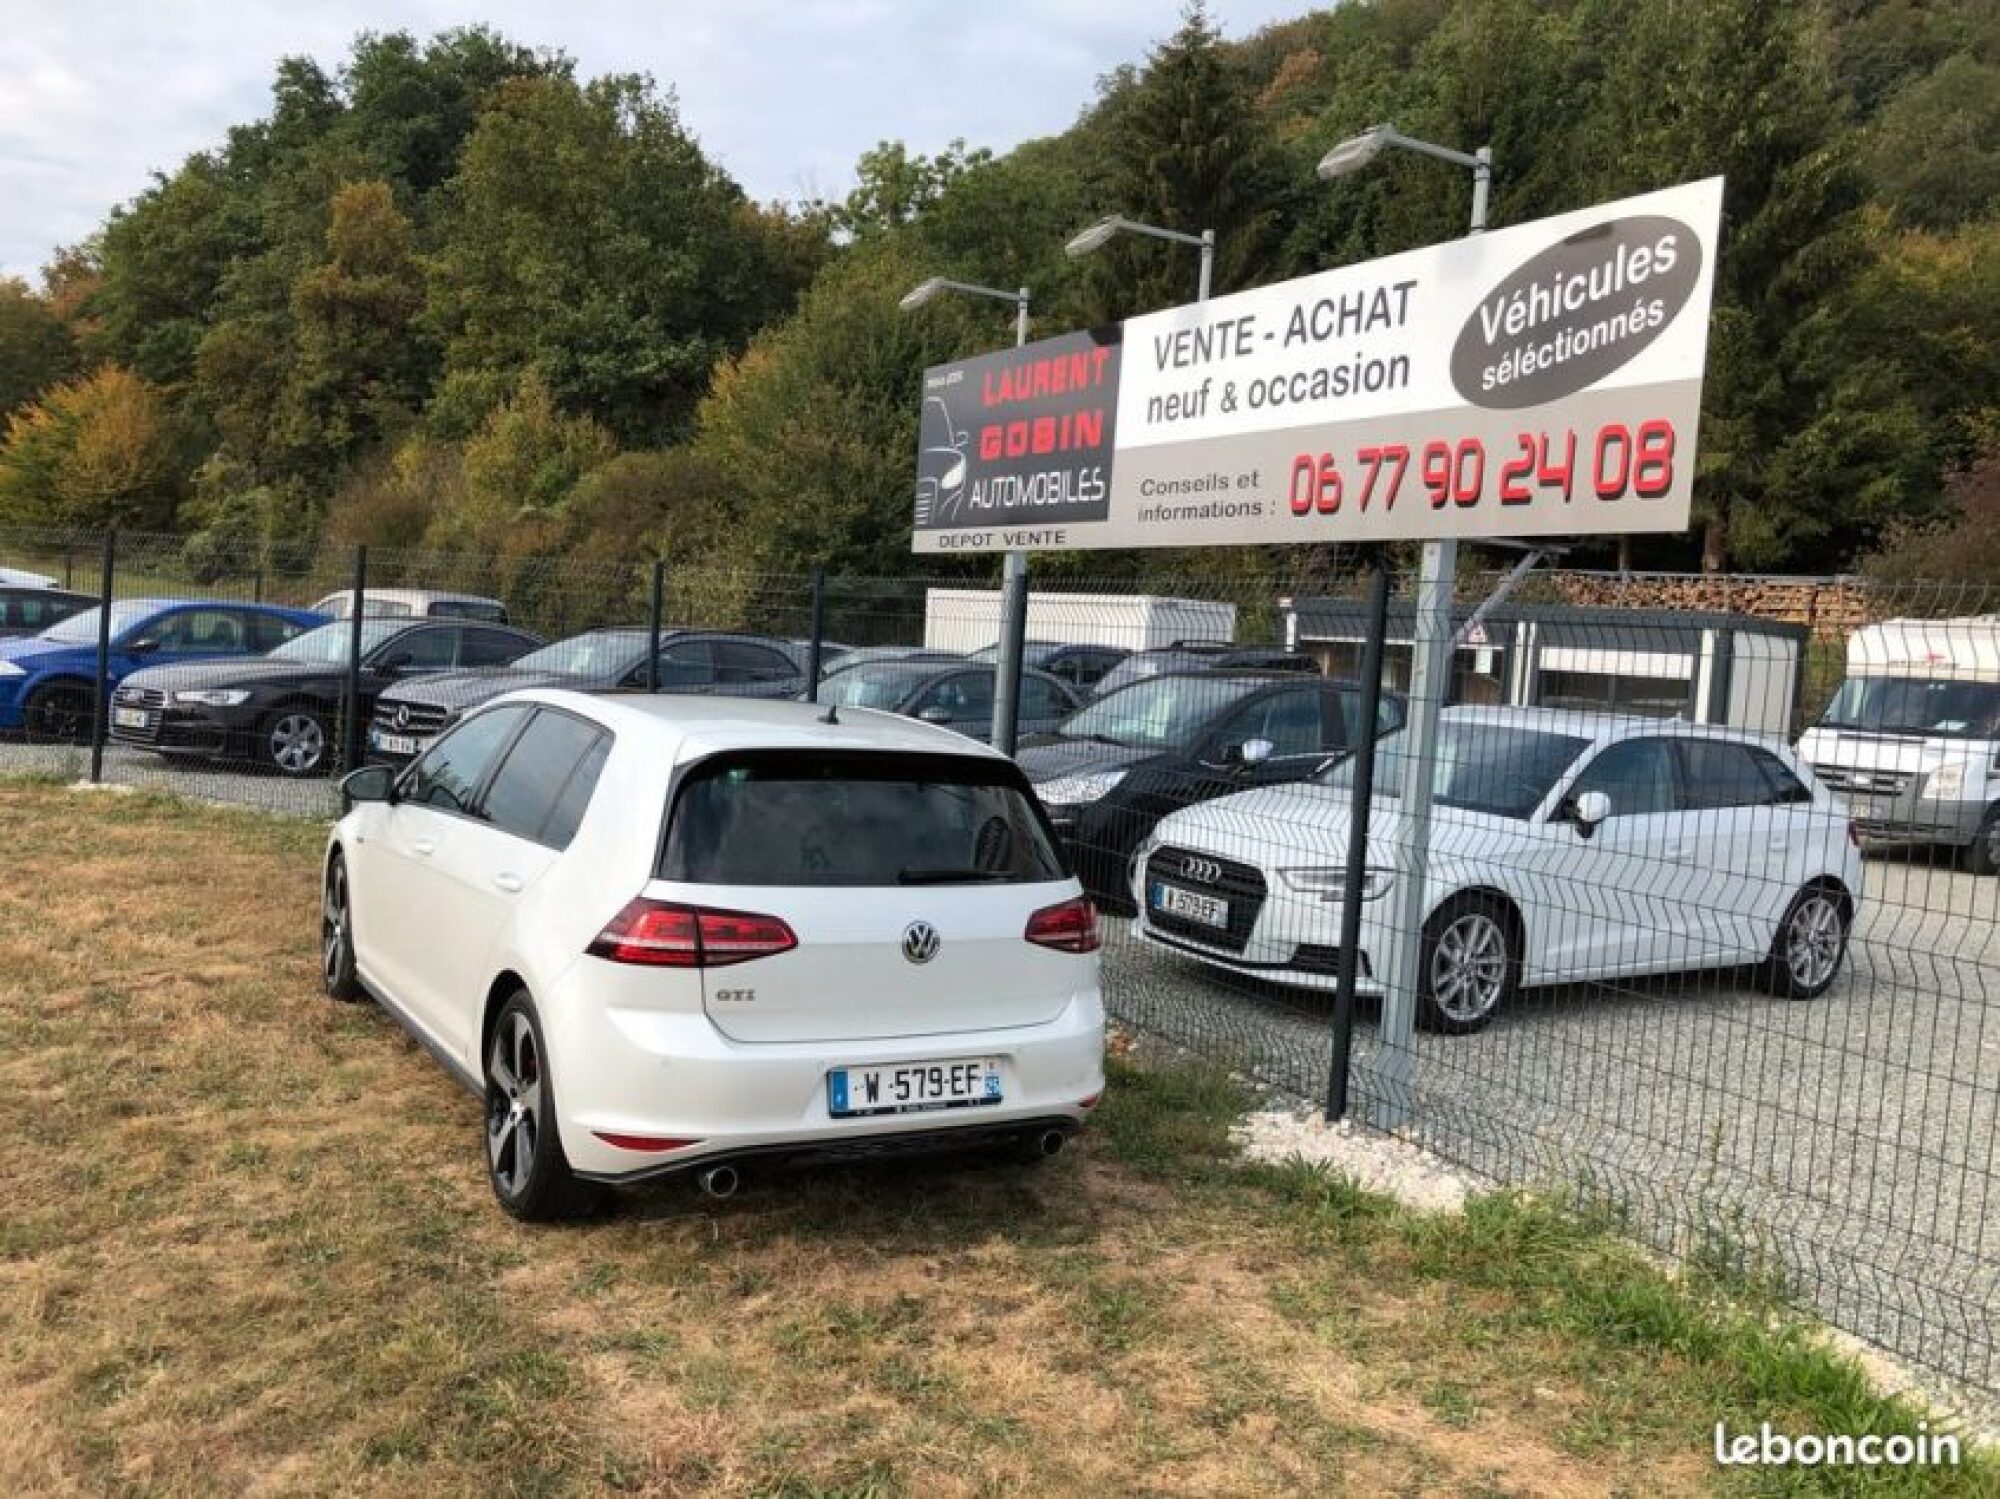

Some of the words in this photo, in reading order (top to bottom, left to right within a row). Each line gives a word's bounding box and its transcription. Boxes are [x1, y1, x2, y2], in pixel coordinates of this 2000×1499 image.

[1480, 235, 1677, 345] Véhicules
[1154, 315, 1256, 371] VENTE
[1284, 280, 1418, 347] ACHAT
[1482, 297, 1664, 391] séléctionnés
[982, 346, 1110, 406] LAURENT
[1147, 378, 1212, 424] neuf
[1220, 381, 1238, 413] &
[1248, 352, 1410, 408] occasion
[979, 408, 1105, 461] GOBIN
[968, 466, 1106, 509] AUTOMOBILES
[1140, 473, 1229, 496] Conseils
[1236, 470, 1259, 489] et
[1289, 452, 1343, 516] 06
[1356, 443, 1410, 513] 77
[1421, 437, 1485, 510] 90
[1500, 428, 1577, 505] 24
[1593, 418, 1676, 501] 08
[939, 533, 994, 548] DEPOT
[1003, 530, 1067, 546] VENTE
[1138, 501, 1262, 522] informations
[715, 988, 756, 1002] GTI
